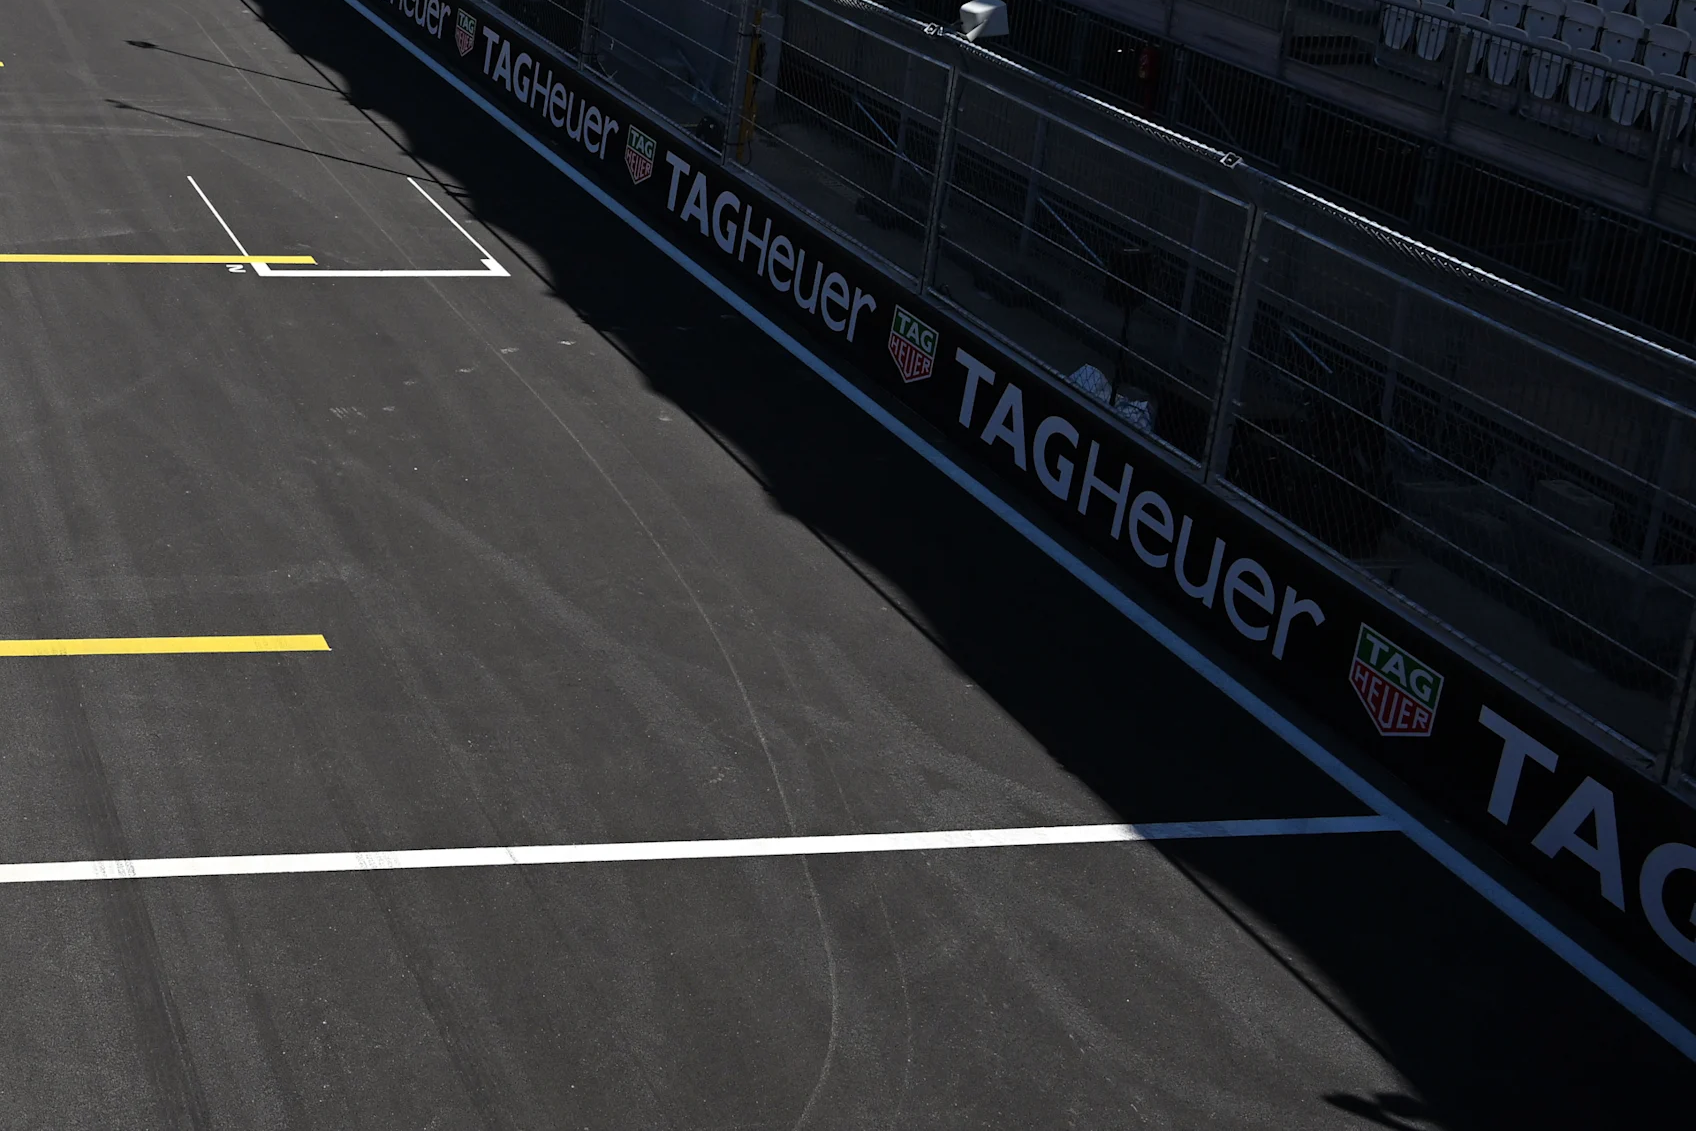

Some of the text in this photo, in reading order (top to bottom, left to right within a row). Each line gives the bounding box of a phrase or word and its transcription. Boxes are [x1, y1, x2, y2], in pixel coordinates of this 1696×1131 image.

[455, 28, 474, 53] HEUER
[458, 12, 476, 34] TAG
[483, 26, 620, 160] TAGHeuer
[625, 147, 652, 182] HEUER
[630, 129, 655, 156] TAG
[666, 150, 877, 343] TAGHeuer
[898, 312, 934, 353] TAG
[890, 335, 932, 380] HEUER
[955, 348, 1326, 660] TAGHeuer
[1365, 632, 1436, 699] TAG
[1353, 664, 1432, 732] HEUER
